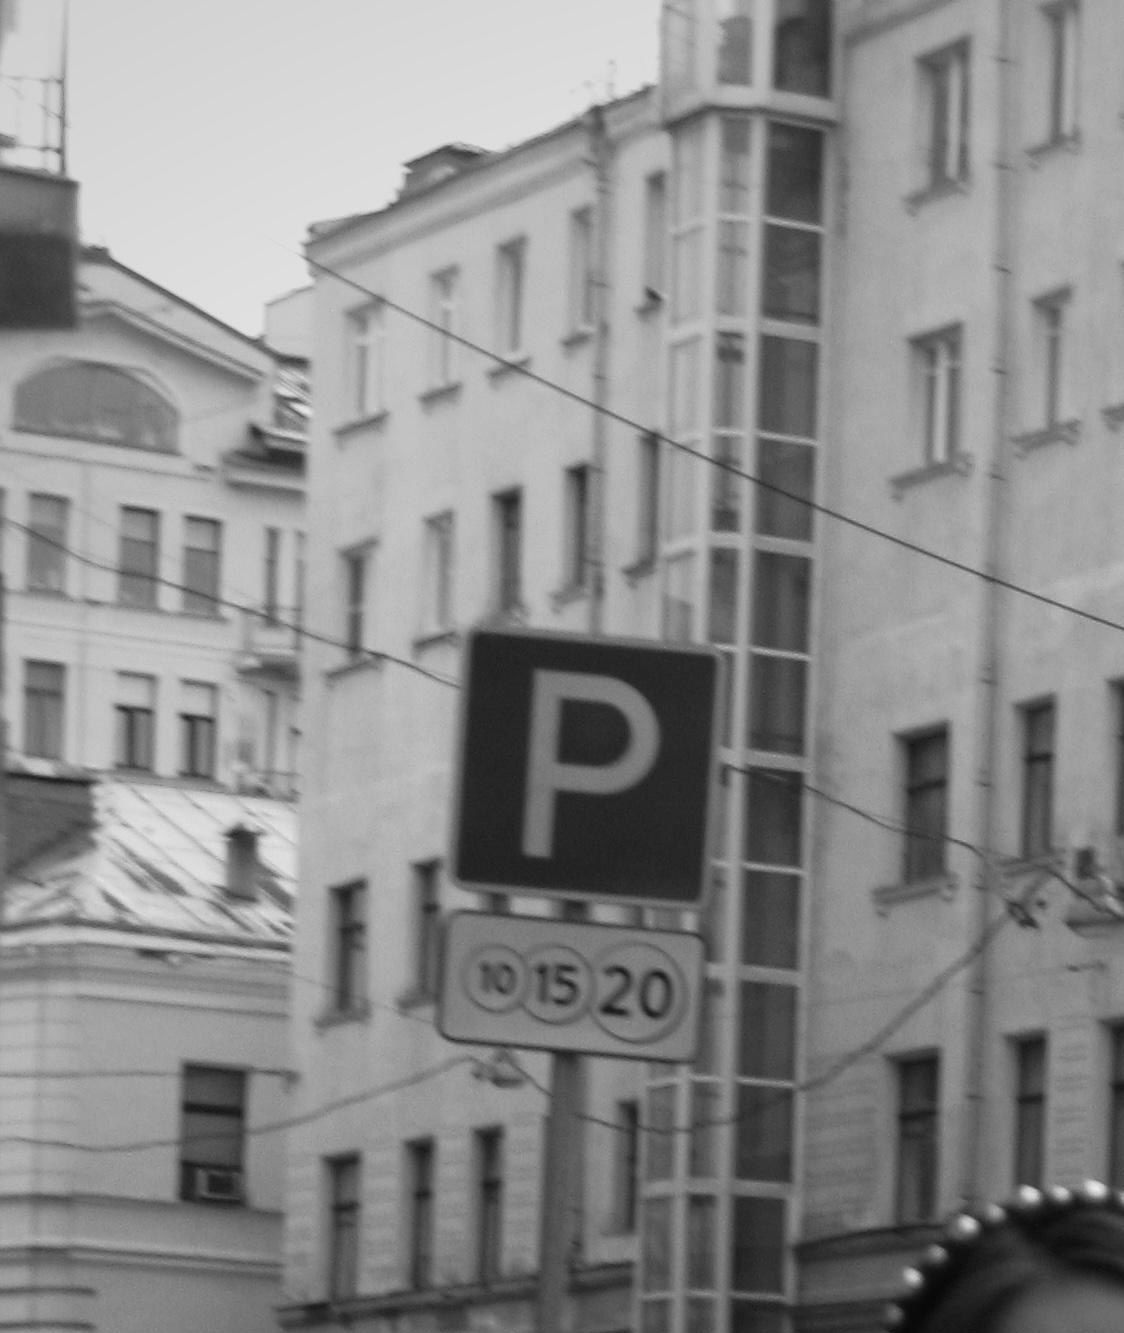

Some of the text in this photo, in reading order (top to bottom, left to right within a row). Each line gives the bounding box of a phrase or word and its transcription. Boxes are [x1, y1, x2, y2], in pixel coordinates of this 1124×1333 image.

[522, 668, 661, 859] P
[478, 961, 674, 1019] 10 15 20
